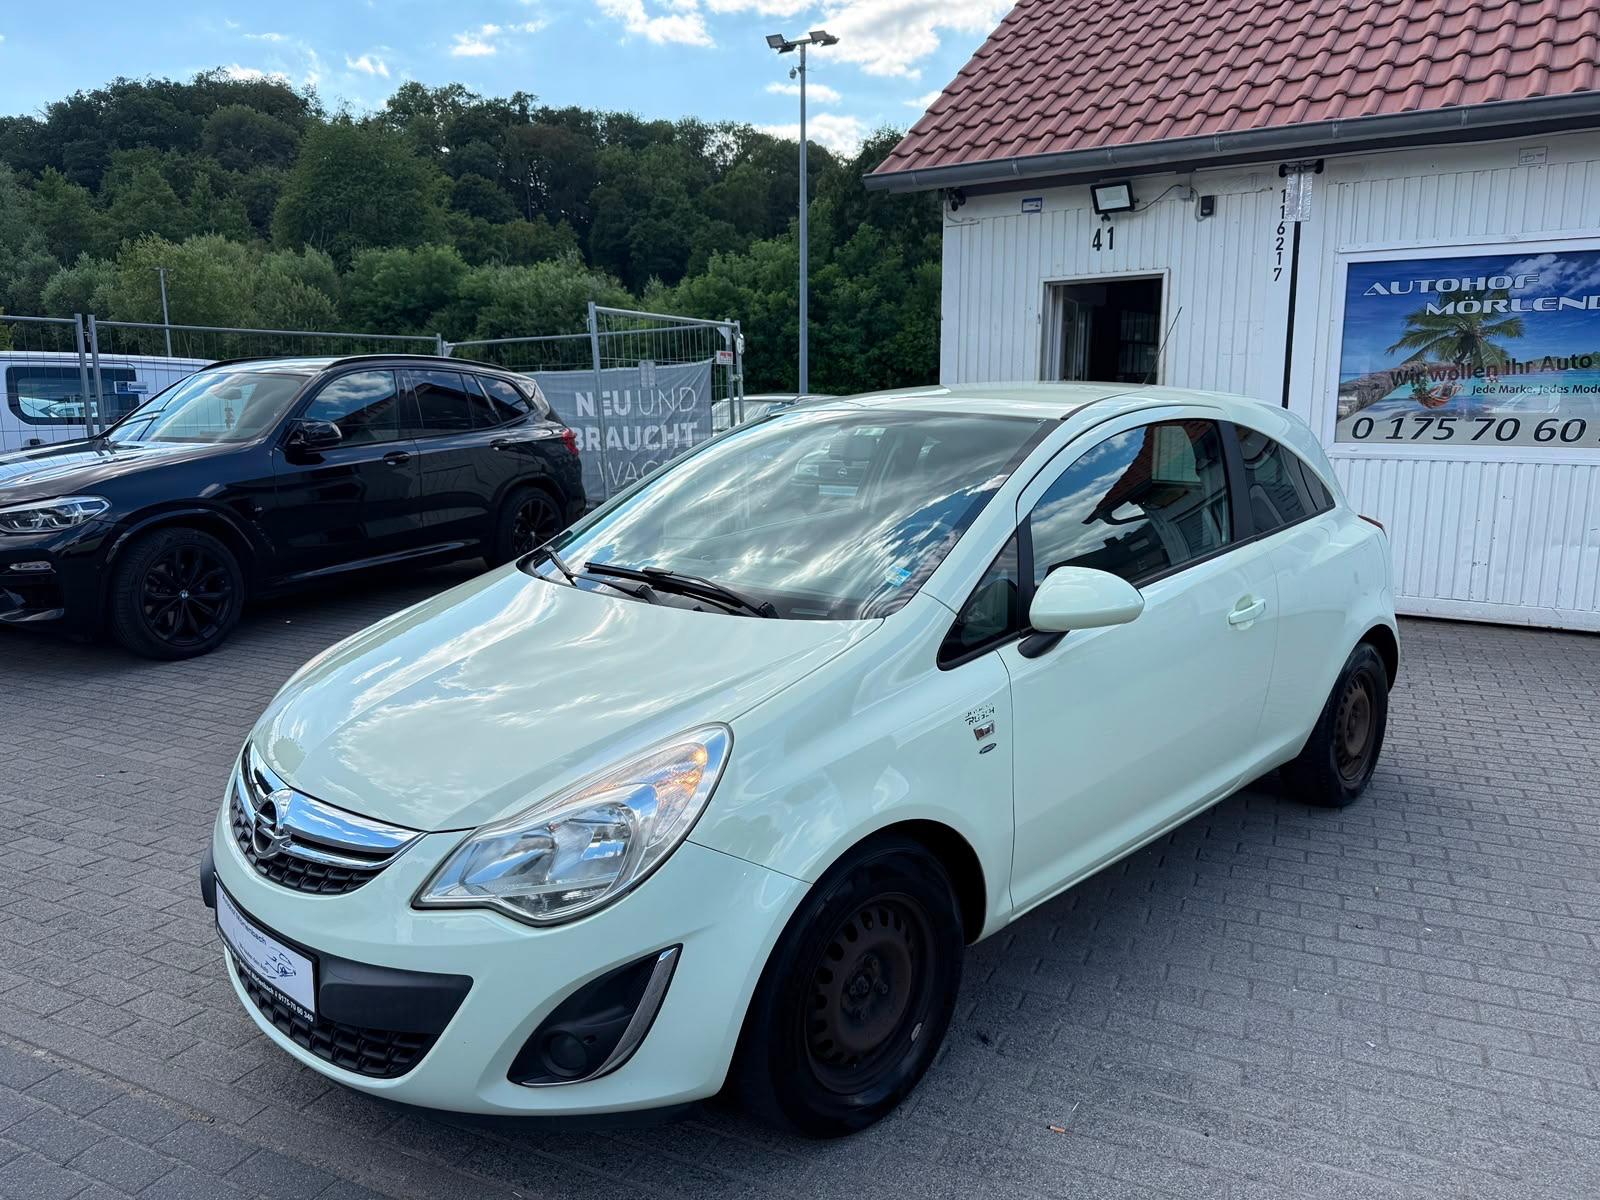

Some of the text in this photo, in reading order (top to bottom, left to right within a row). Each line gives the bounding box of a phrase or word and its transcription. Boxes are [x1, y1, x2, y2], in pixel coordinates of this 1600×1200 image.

[1092, 225, 1115, 251] 41
[1363, 273, 1540, 296] AUTOHOF
[1430, 361, 1498, 382] wollen
[1505, 357, 1534, 376] Ihr
[1540, 354, 1593, 373] Auto
[575, 386, 696, 417] NEU UND
[1472, 384, 1496, 396] Jede
[1351, 417, 1587, 443] 0 175 70 60
